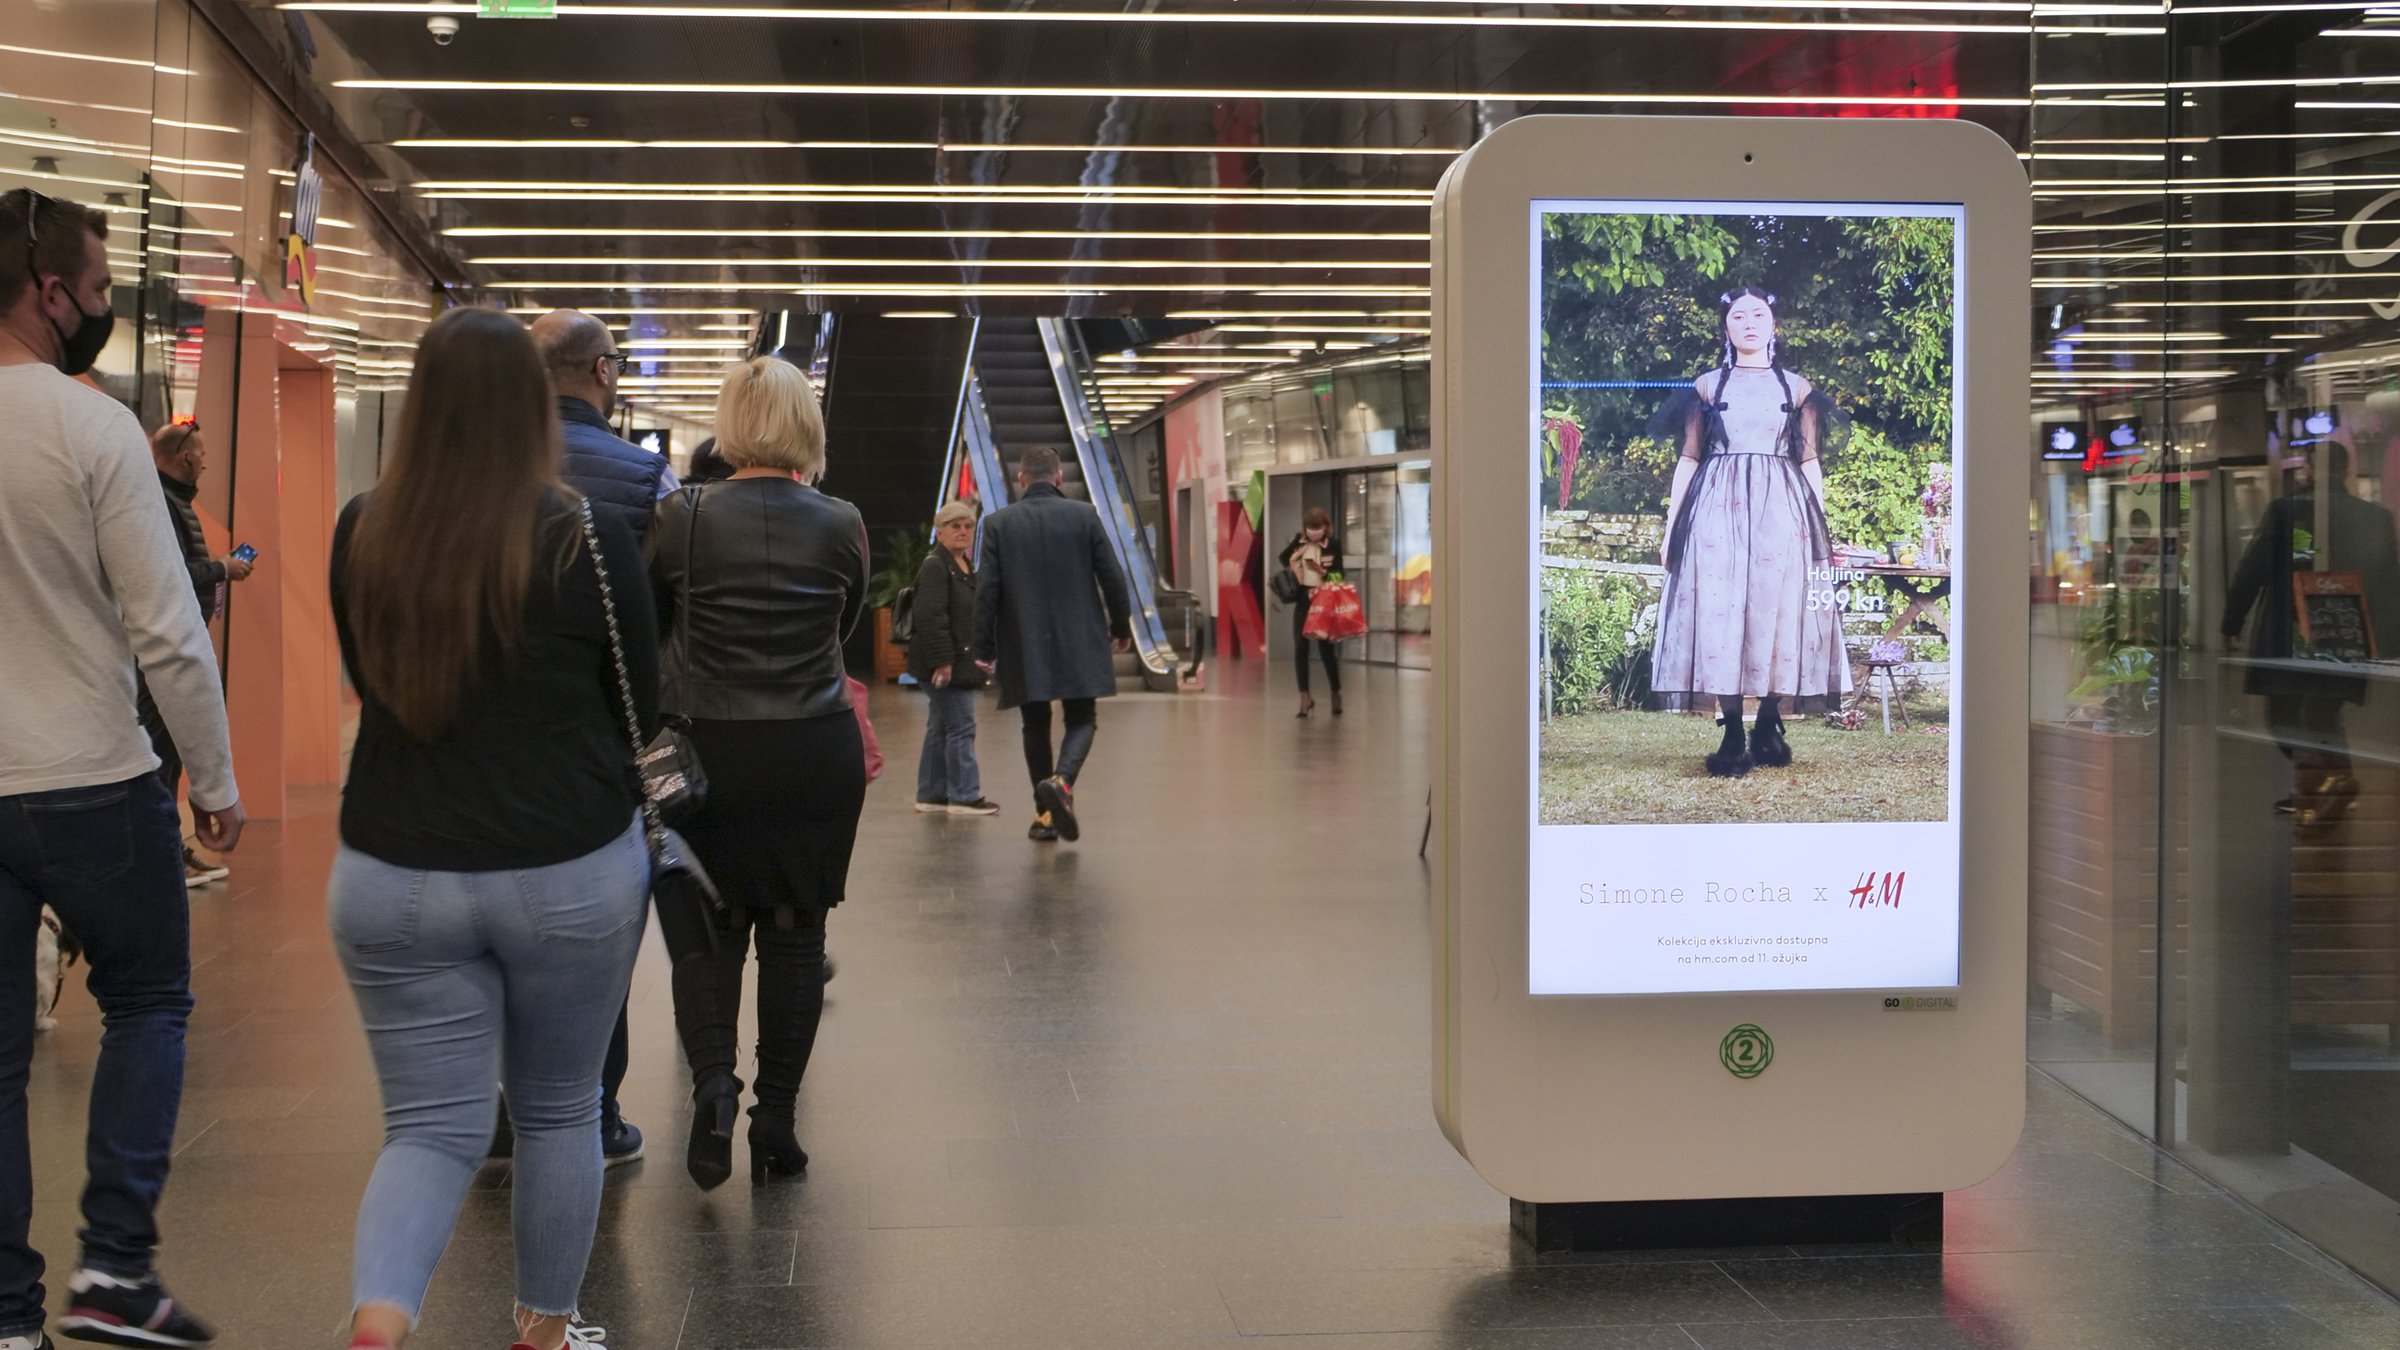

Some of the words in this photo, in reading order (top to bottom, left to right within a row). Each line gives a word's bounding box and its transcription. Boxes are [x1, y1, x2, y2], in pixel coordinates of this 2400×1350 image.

[1807, 566, 1865, 585] Haljina
[1806, 589, 1850, 611] 599
[1855, 588, 1884, 611] kn
[1579, 882, 1684, 905] Simone
[1704, 881, 1793, 903] Rocha
[1812, 887, 1829, 902] x
[1848, 870, 1906, 911] H&M
[1657, 936, 1707, 948] Kolekcija
[1709, 935, 1774, 946] ekskluzivno
[1775, 935, 1829, 947] dostupna
[1677, 956, 1692, 964] na
[1694, 954, 1738, 964] hm.com
[1740, 953, 1755, 964] od
[1757, 953, 1770, 963] 11.
[1771, 952, 1808, 965] ožujka
[1884, 998, 1900, 1008] GO
[1916, 997, 1956, 1008] DIGITAL
[1739, 1039, 1754, 1061] 2
